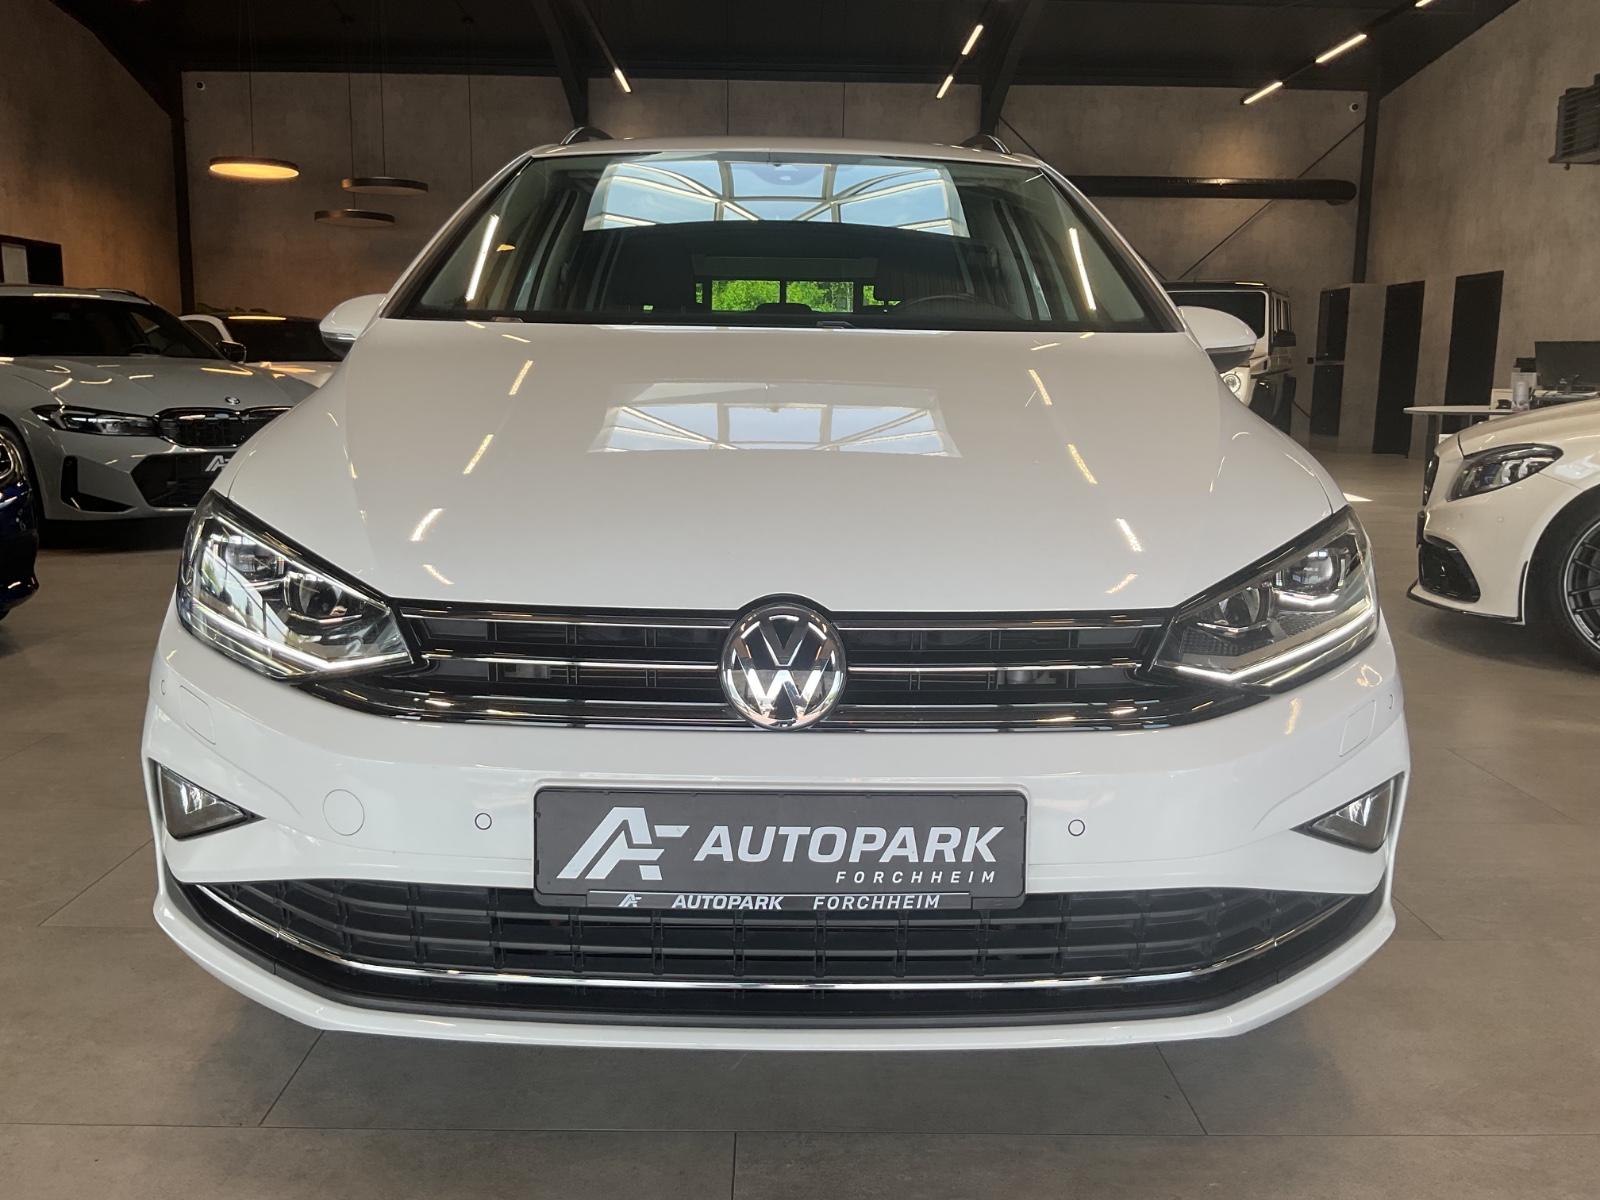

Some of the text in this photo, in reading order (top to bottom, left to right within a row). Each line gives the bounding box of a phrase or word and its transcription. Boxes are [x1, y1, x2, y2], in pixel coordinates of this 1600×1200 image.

[725, 608, 841, 724] VW
[693, 825, 1004, 863] AUTOPARK
[835, 871, 995, 884] FORCHHEIM
[671, 894, 784, 910] AUTOPARK
[812, 895, 940, 910] FORCHHEIM
